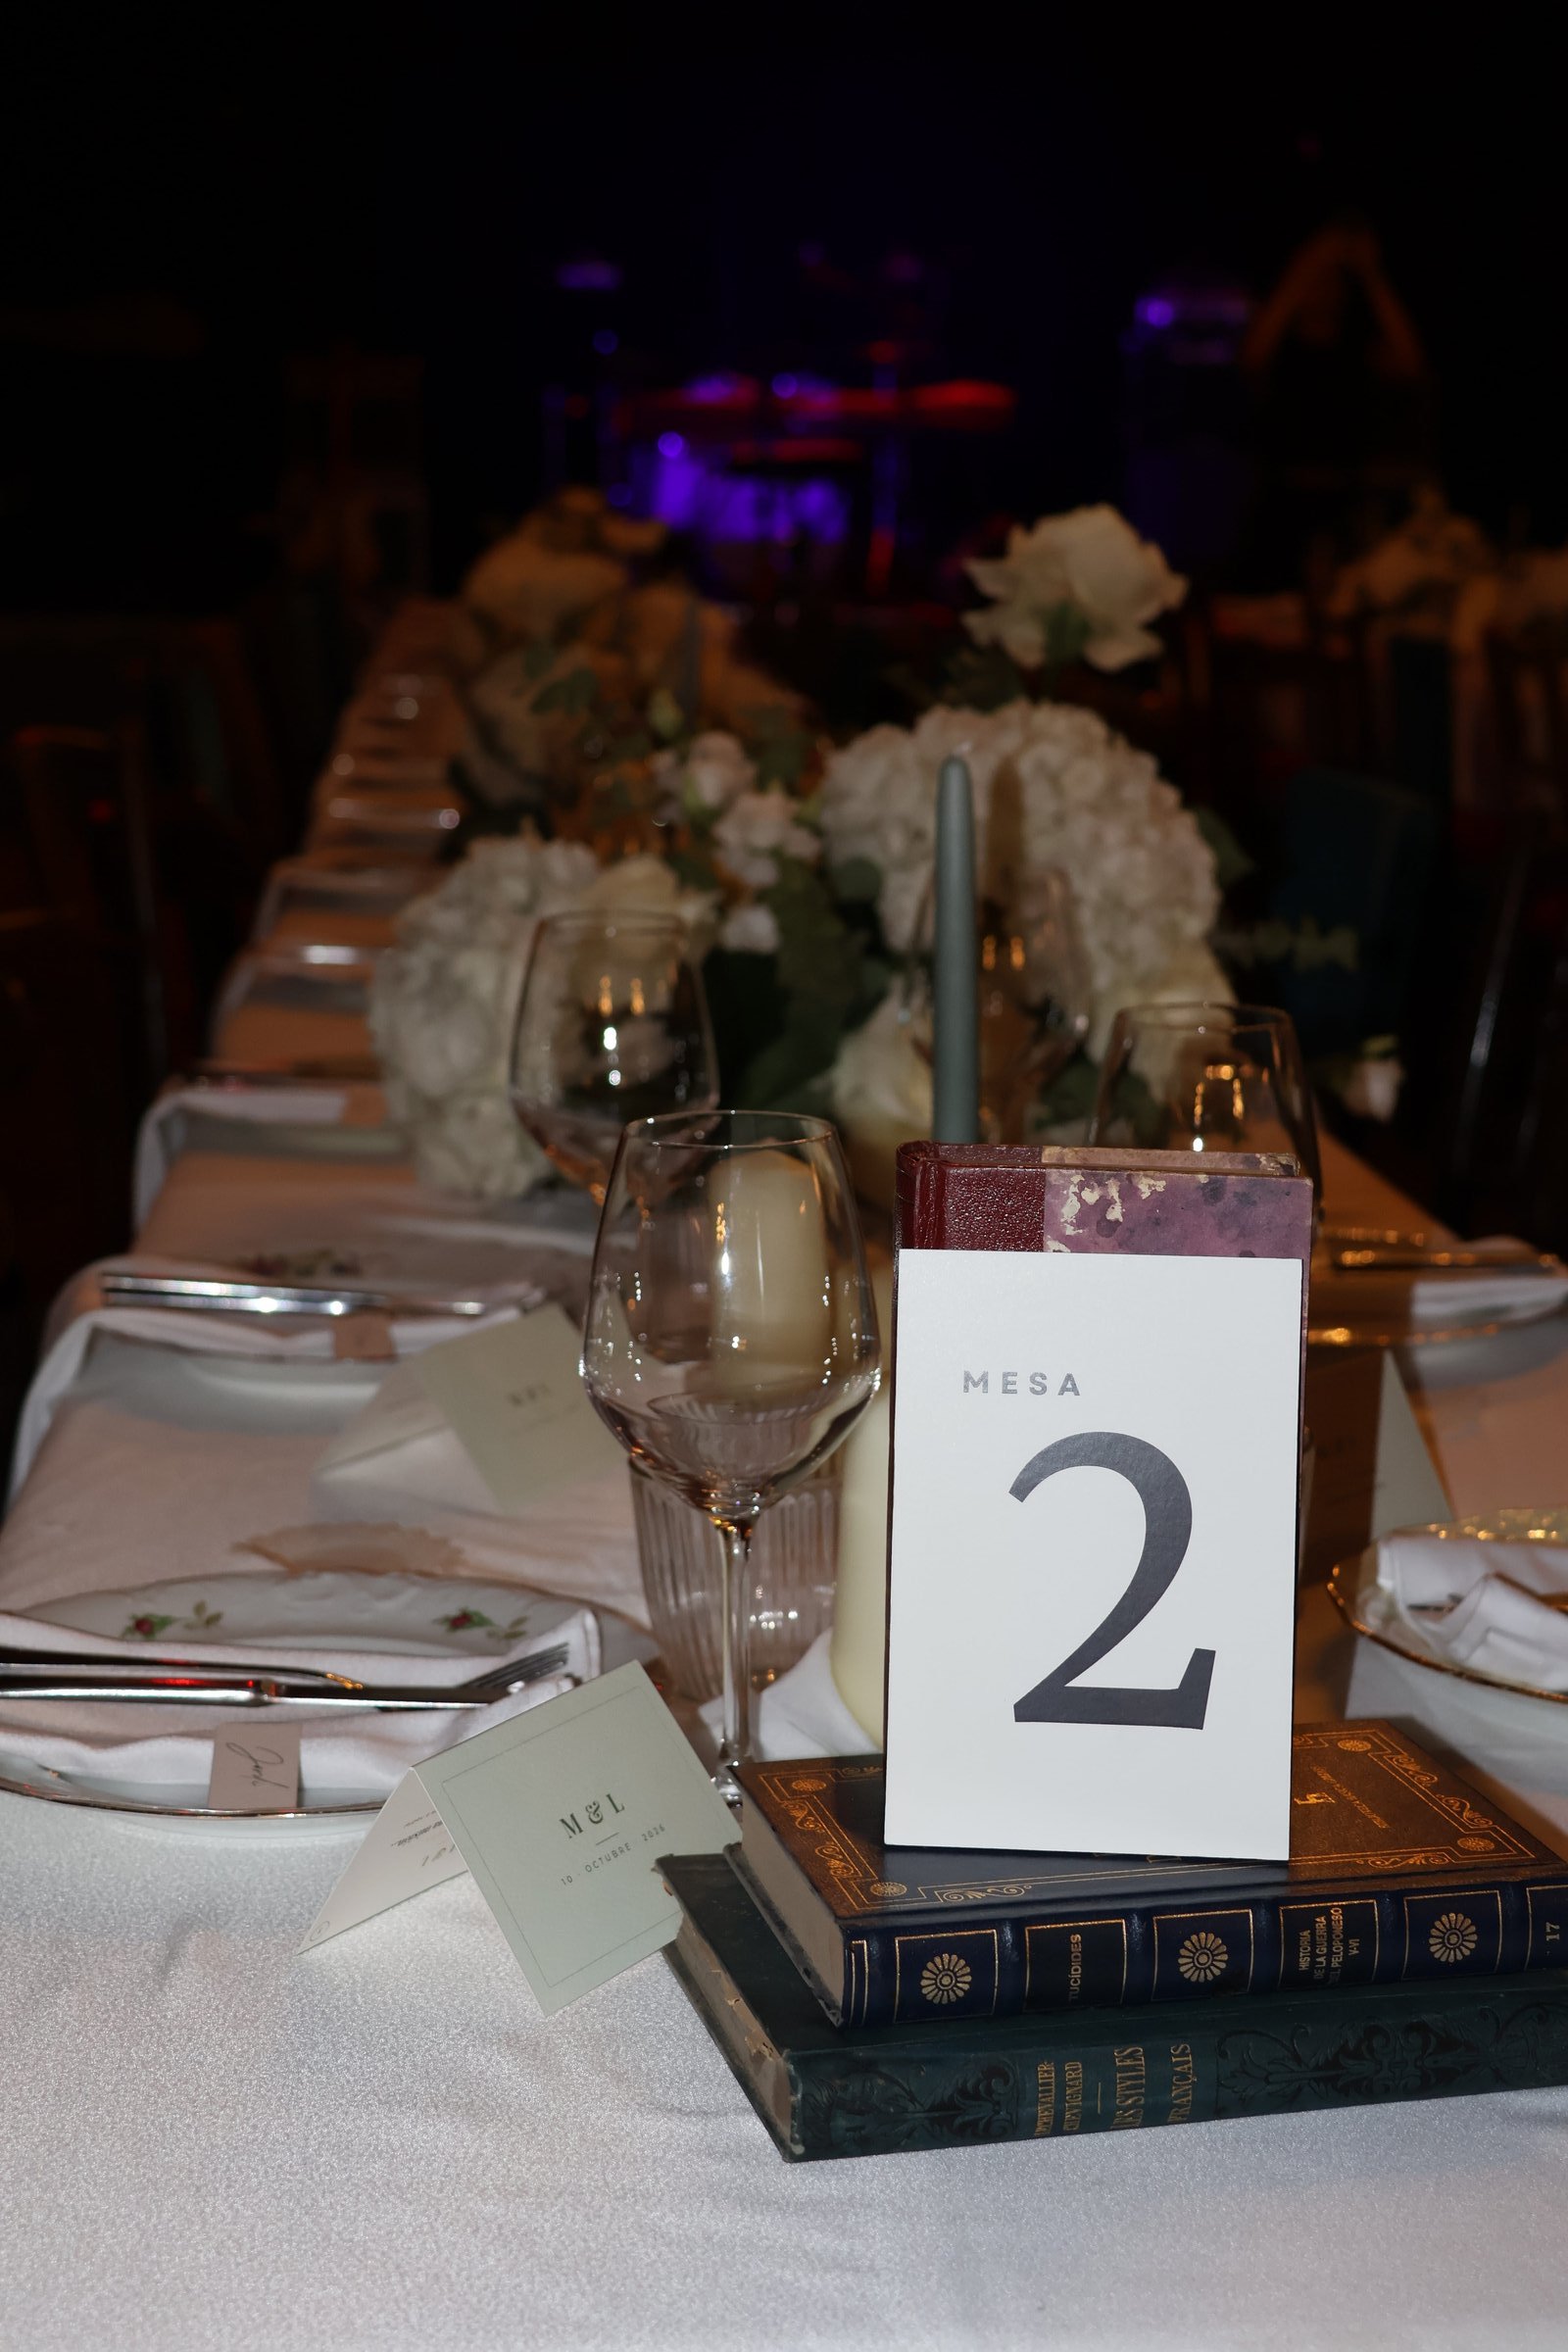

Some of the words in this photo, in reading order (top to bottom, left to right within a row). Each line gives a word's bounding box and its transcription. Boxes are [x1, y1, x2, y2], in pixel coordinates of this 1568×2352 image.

[963, 1370, 1080, 1396] MESA
[1008, 1431, 1216, 1730] 2
[557, 1813, 584, 1838] M
[585, 1800, 604, 1824] &
[606, 1793, 625, 1814] L
[561, 1875, 574, 1886] 10
[584, 1841, 632, 1873] OCTUBRE
[1298, 1930, 1311, 1971] HISTORIA
[1315, 1915, 1328, 1955] GUERRA
[1331, 1907, 1344, 1968] PELOPONESO
[1545, 1921, 1560, 1941] 17
[1068, 1934, 1082, 2001] TUCÍDIDES
[1315, 1955, 1327, 1968] LA
[1062, 2061, 1083, 2132] CHEVIGNARD
[1114, 2045, 1145, 2106] STYLES
[1166, 2043, 1197, 2123] FRANÇAIS
